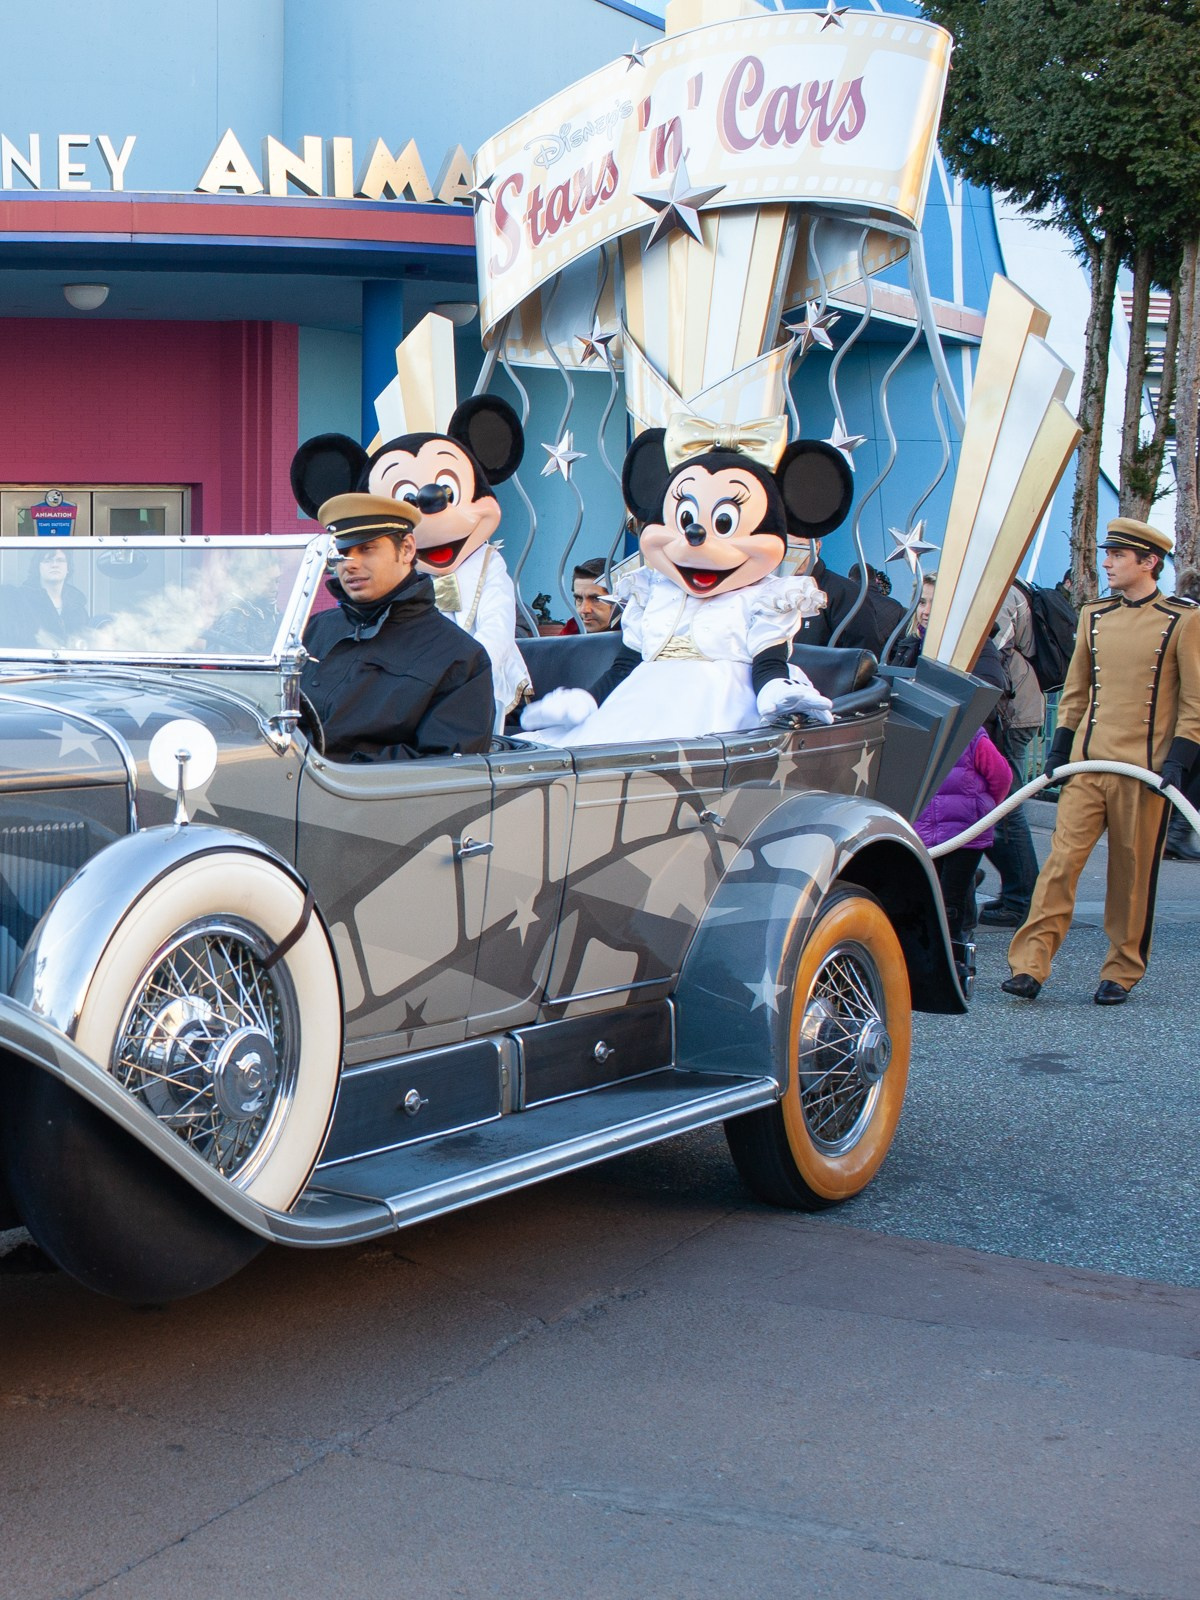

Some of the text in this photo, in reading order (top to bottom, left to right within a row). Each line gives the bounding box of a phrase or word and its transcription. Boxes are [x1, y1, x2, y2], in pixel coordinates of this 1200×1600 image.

[487, 150, 620, 279] Stars
[716, 55, 867, 154] Cars
[523, 99, 634, 169] Disney's
